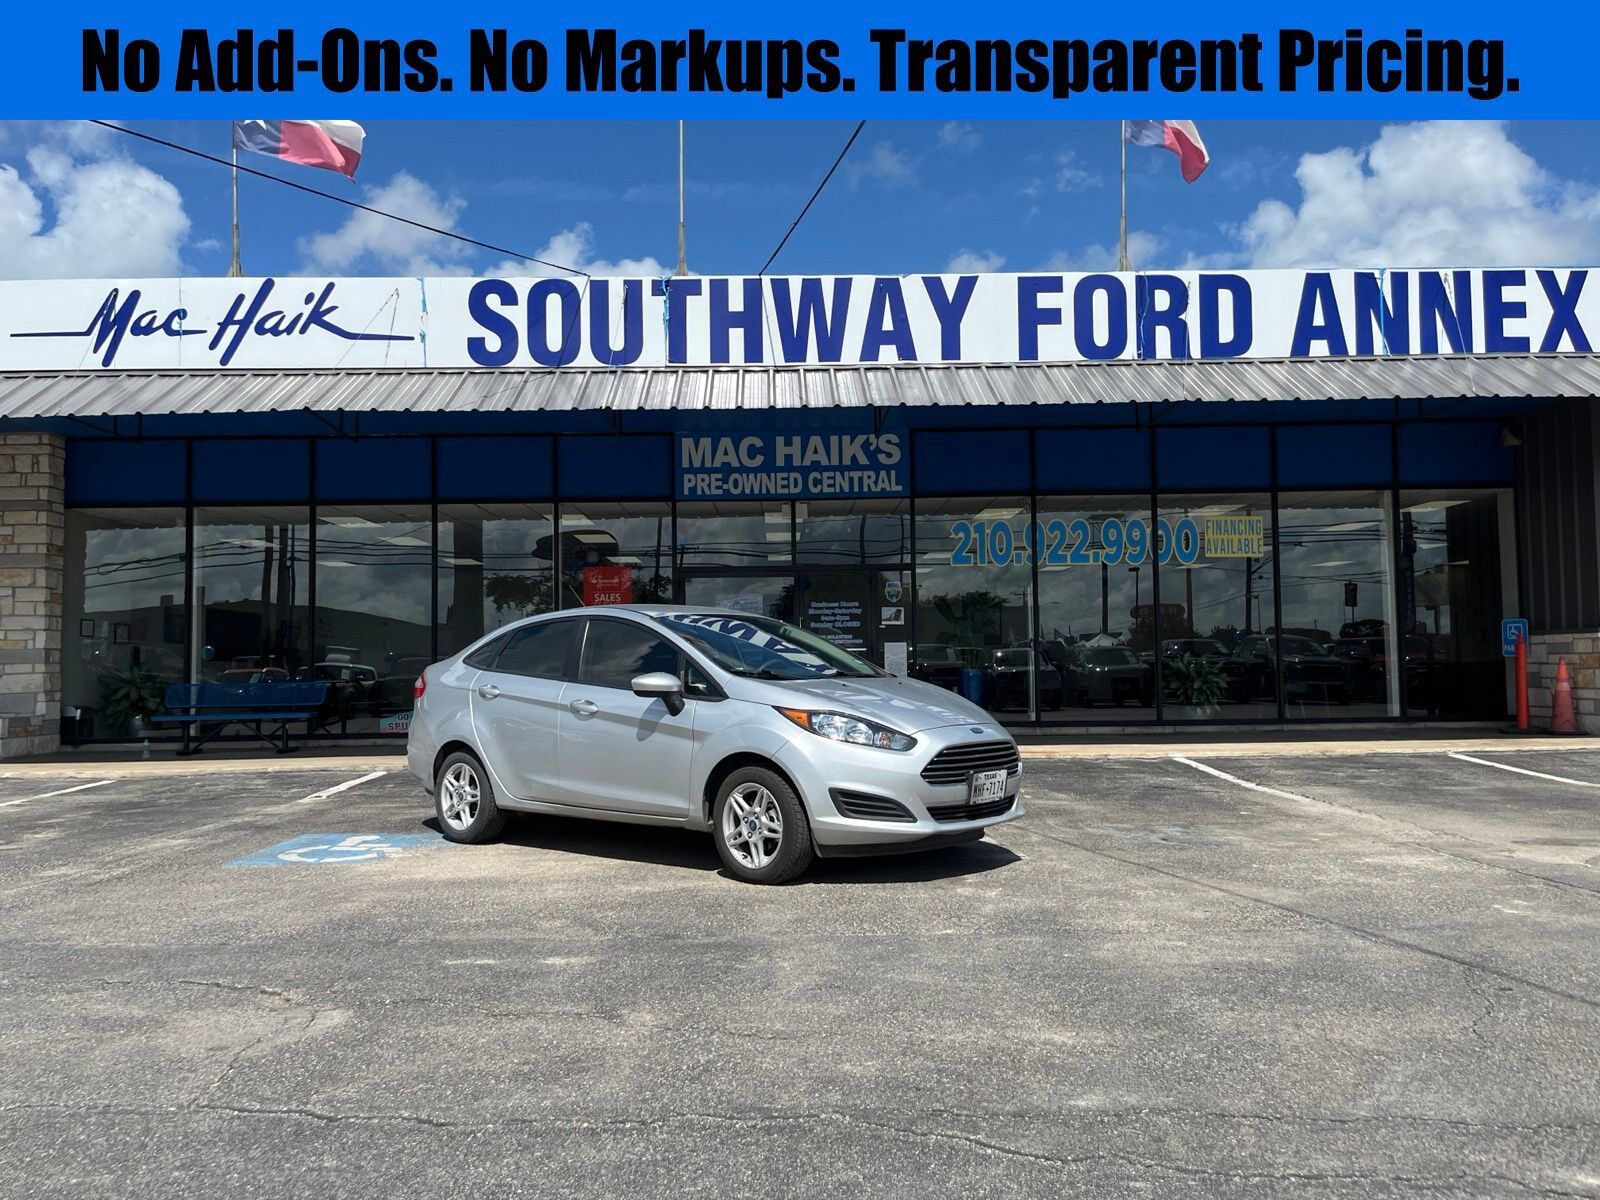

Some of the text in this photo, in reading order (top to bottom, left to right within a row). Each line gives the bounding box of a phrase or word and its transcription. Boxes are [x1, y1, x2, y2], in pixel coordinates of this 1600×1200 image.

[11, 270, 1593, 368] Mac Haik SOUTHWAY FORD ANNEX
[681, 434, 901, 468] MAC HAIK'S
[683, 470, 903, 495] PRE-OWNED CENTRAL
[1206, 520, 1262, 536] FINANCING
[950, 518, 1199, 567] 210.922.9900
[1206, 538, 1263, 554] AVAILABLE
[594, 593, 621, 602] SALES
[388, 723, 410, 731] SPU
